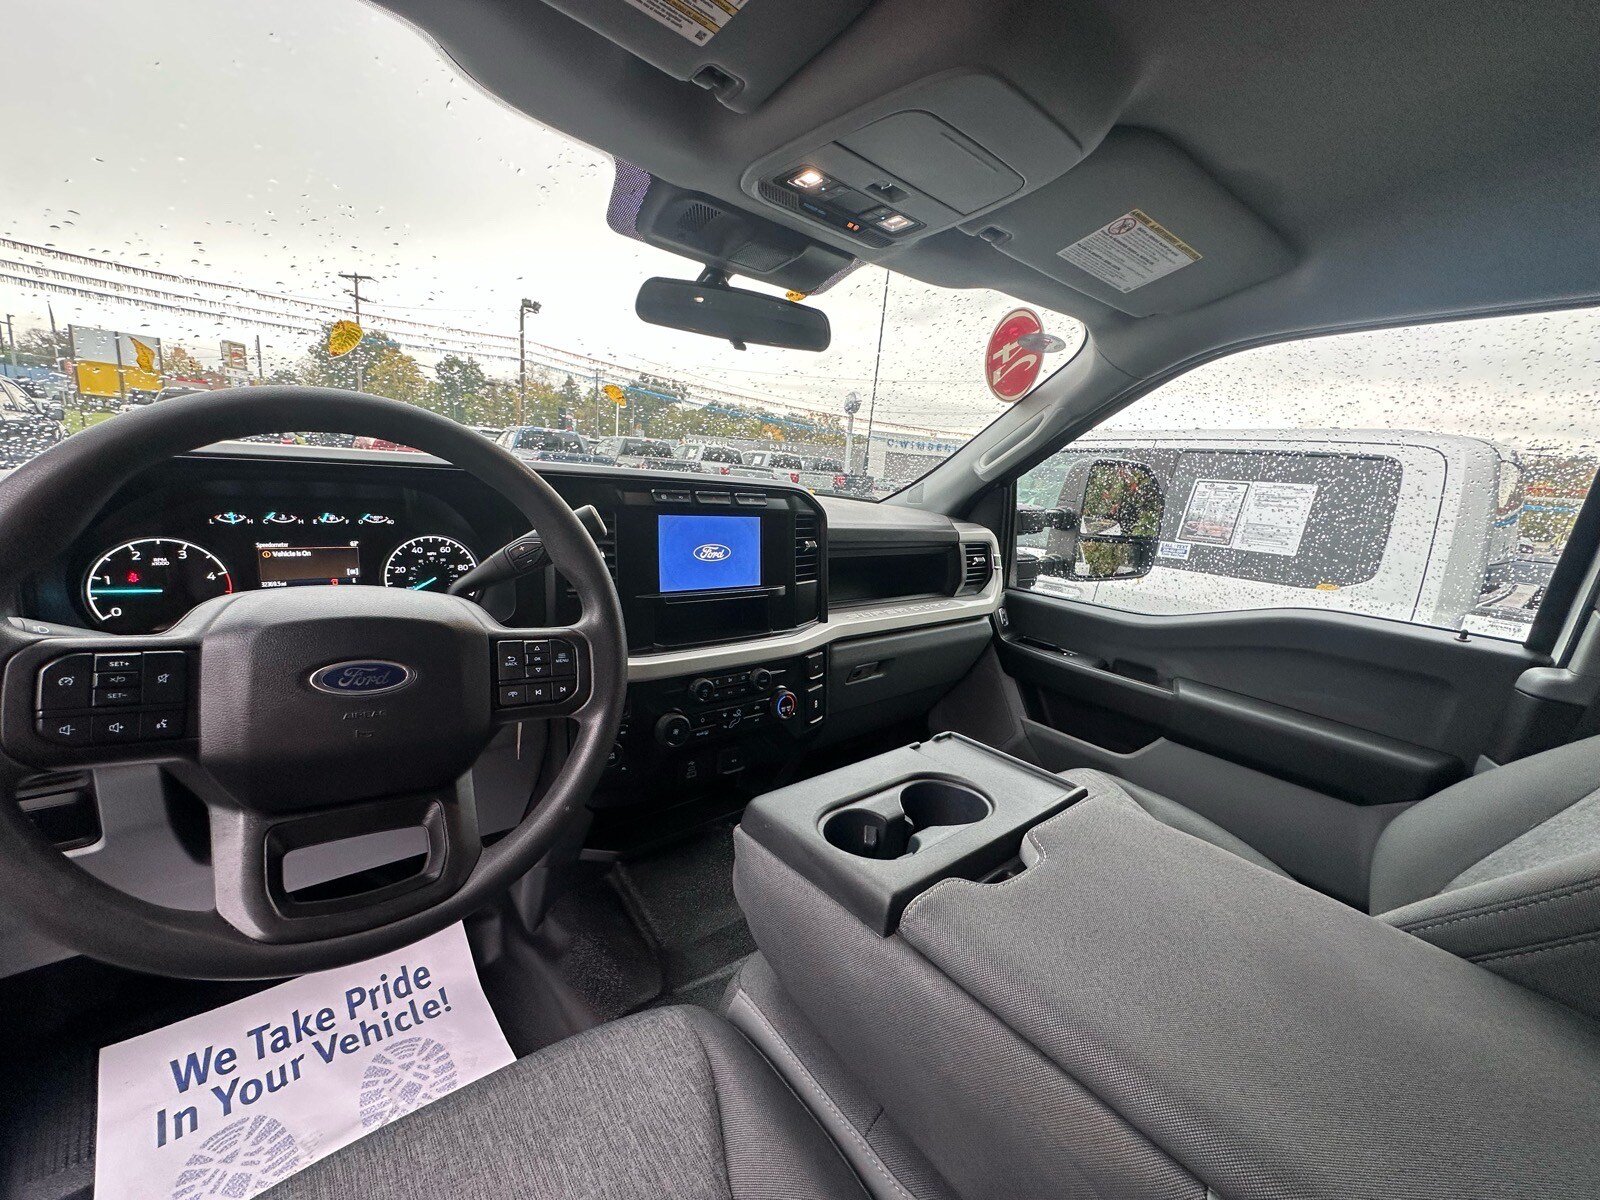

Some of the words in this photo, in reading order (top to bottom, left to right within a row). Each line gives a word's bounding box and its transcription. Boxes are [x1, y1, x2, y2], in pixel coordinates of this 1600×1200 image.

[132, 552, 142, 560] 2
[178, 551, 188, 559] 3
[272, 550, 296, 558] Vehicle
[302, 549, 312, 557] On
[700, 546, 725, 559] Ford
[104, 575, 111, 585] 1
[206, 572, 216, 580] 4
[111, 607, 122, 616] 0
[338, 667, 390, 687] Ford
[170, 1047, 237, 1093] We
[247, 1006, 336, 1061] Take
[345, 965, 432, 1021] Pride
[156, 1108, 198, 1149] In
[210, 1053, 305, 1117] Your
[311, 987, 452, 1064] Vehicle!
